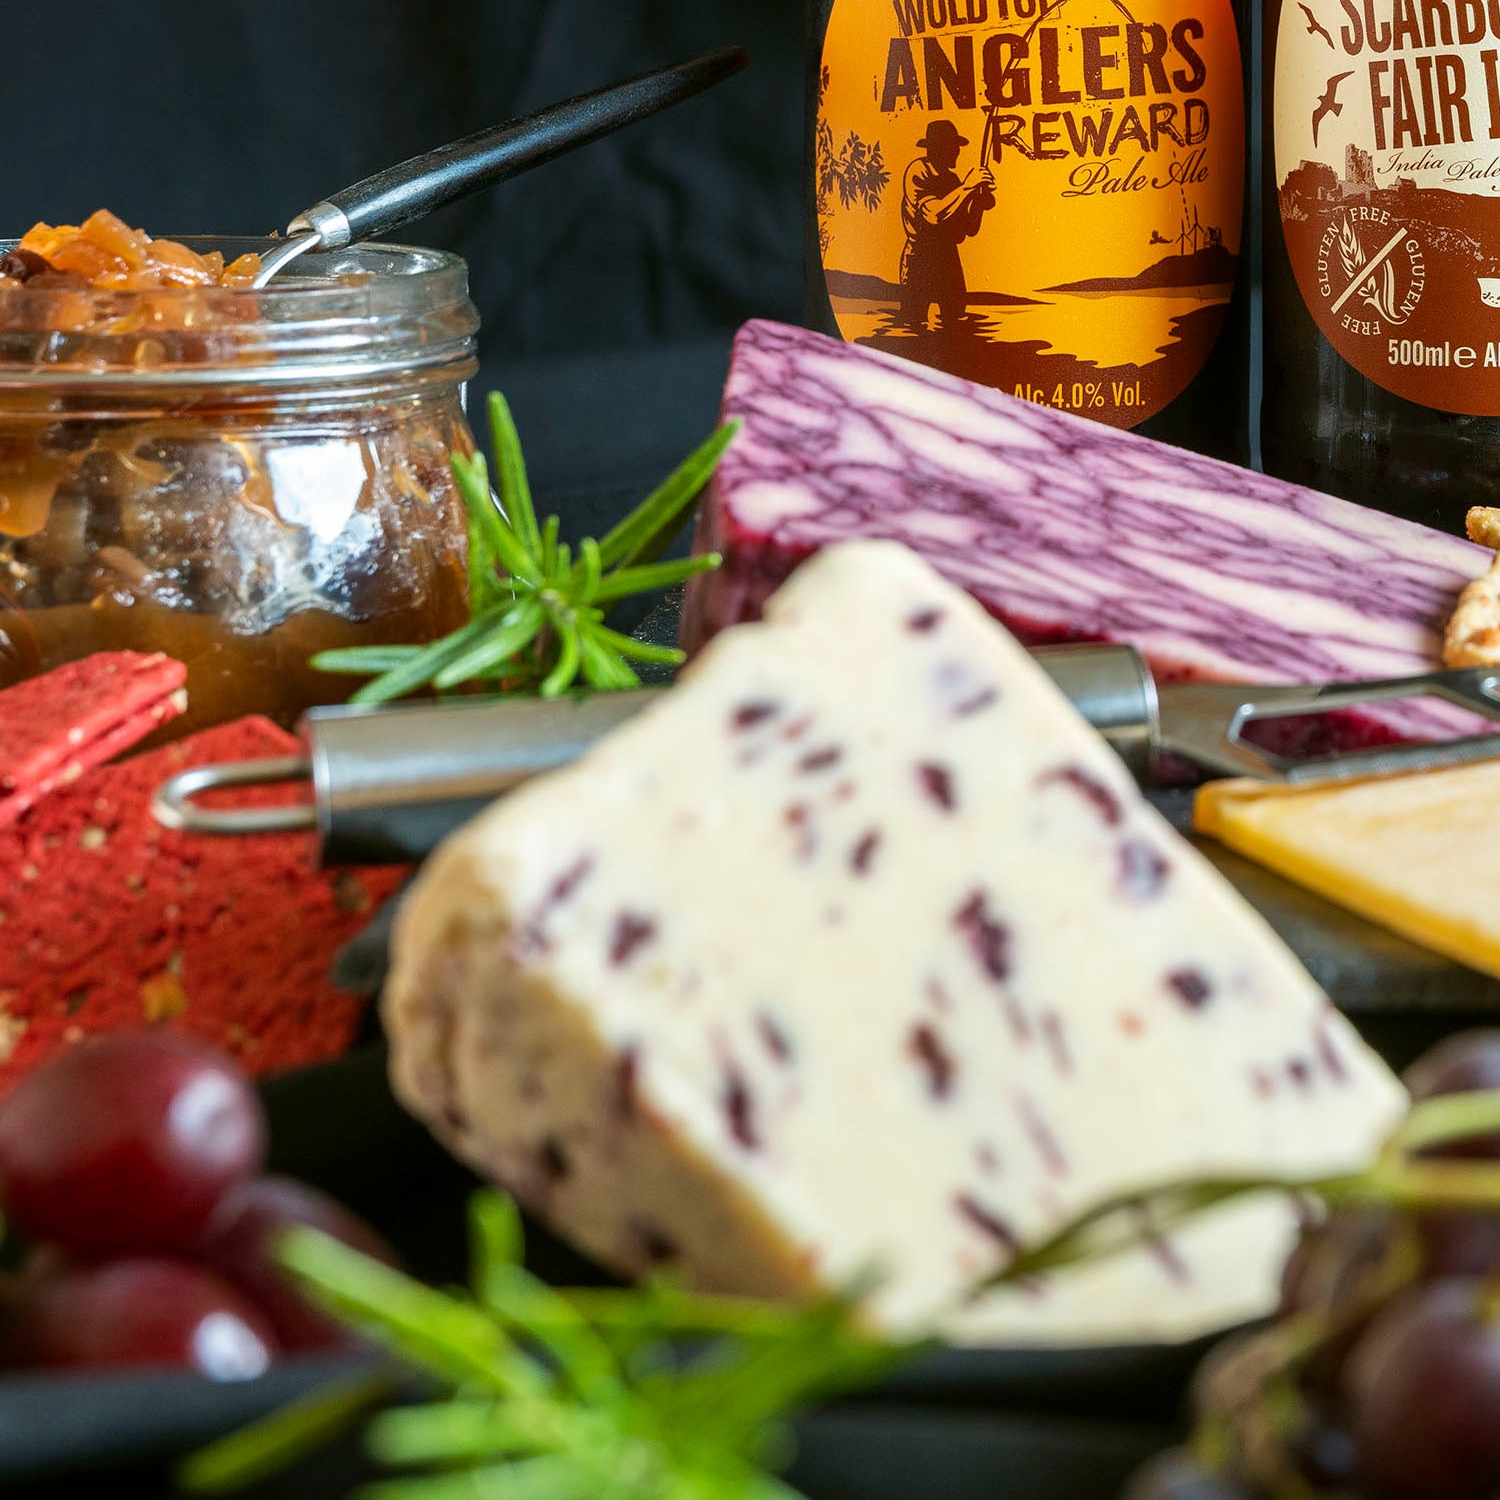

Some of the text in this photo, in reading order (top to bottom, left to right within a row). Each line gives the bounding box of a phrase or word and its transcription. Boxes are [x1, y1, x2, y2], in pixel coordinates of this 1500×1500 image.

[880, 17, 1207, 113] ANGLERS
[990, 98, 1210, 164] REWARD
[1368, 53, 1474, 151] FAIR
[1061, 147, 1209, 198] Pale Ale
[1376, 148, 1446, 174] India
[1317, 206, 1426, 336] GLUTEN FREE GLUTEN FREE
[1112, 380, 1146, 406] Vol.
